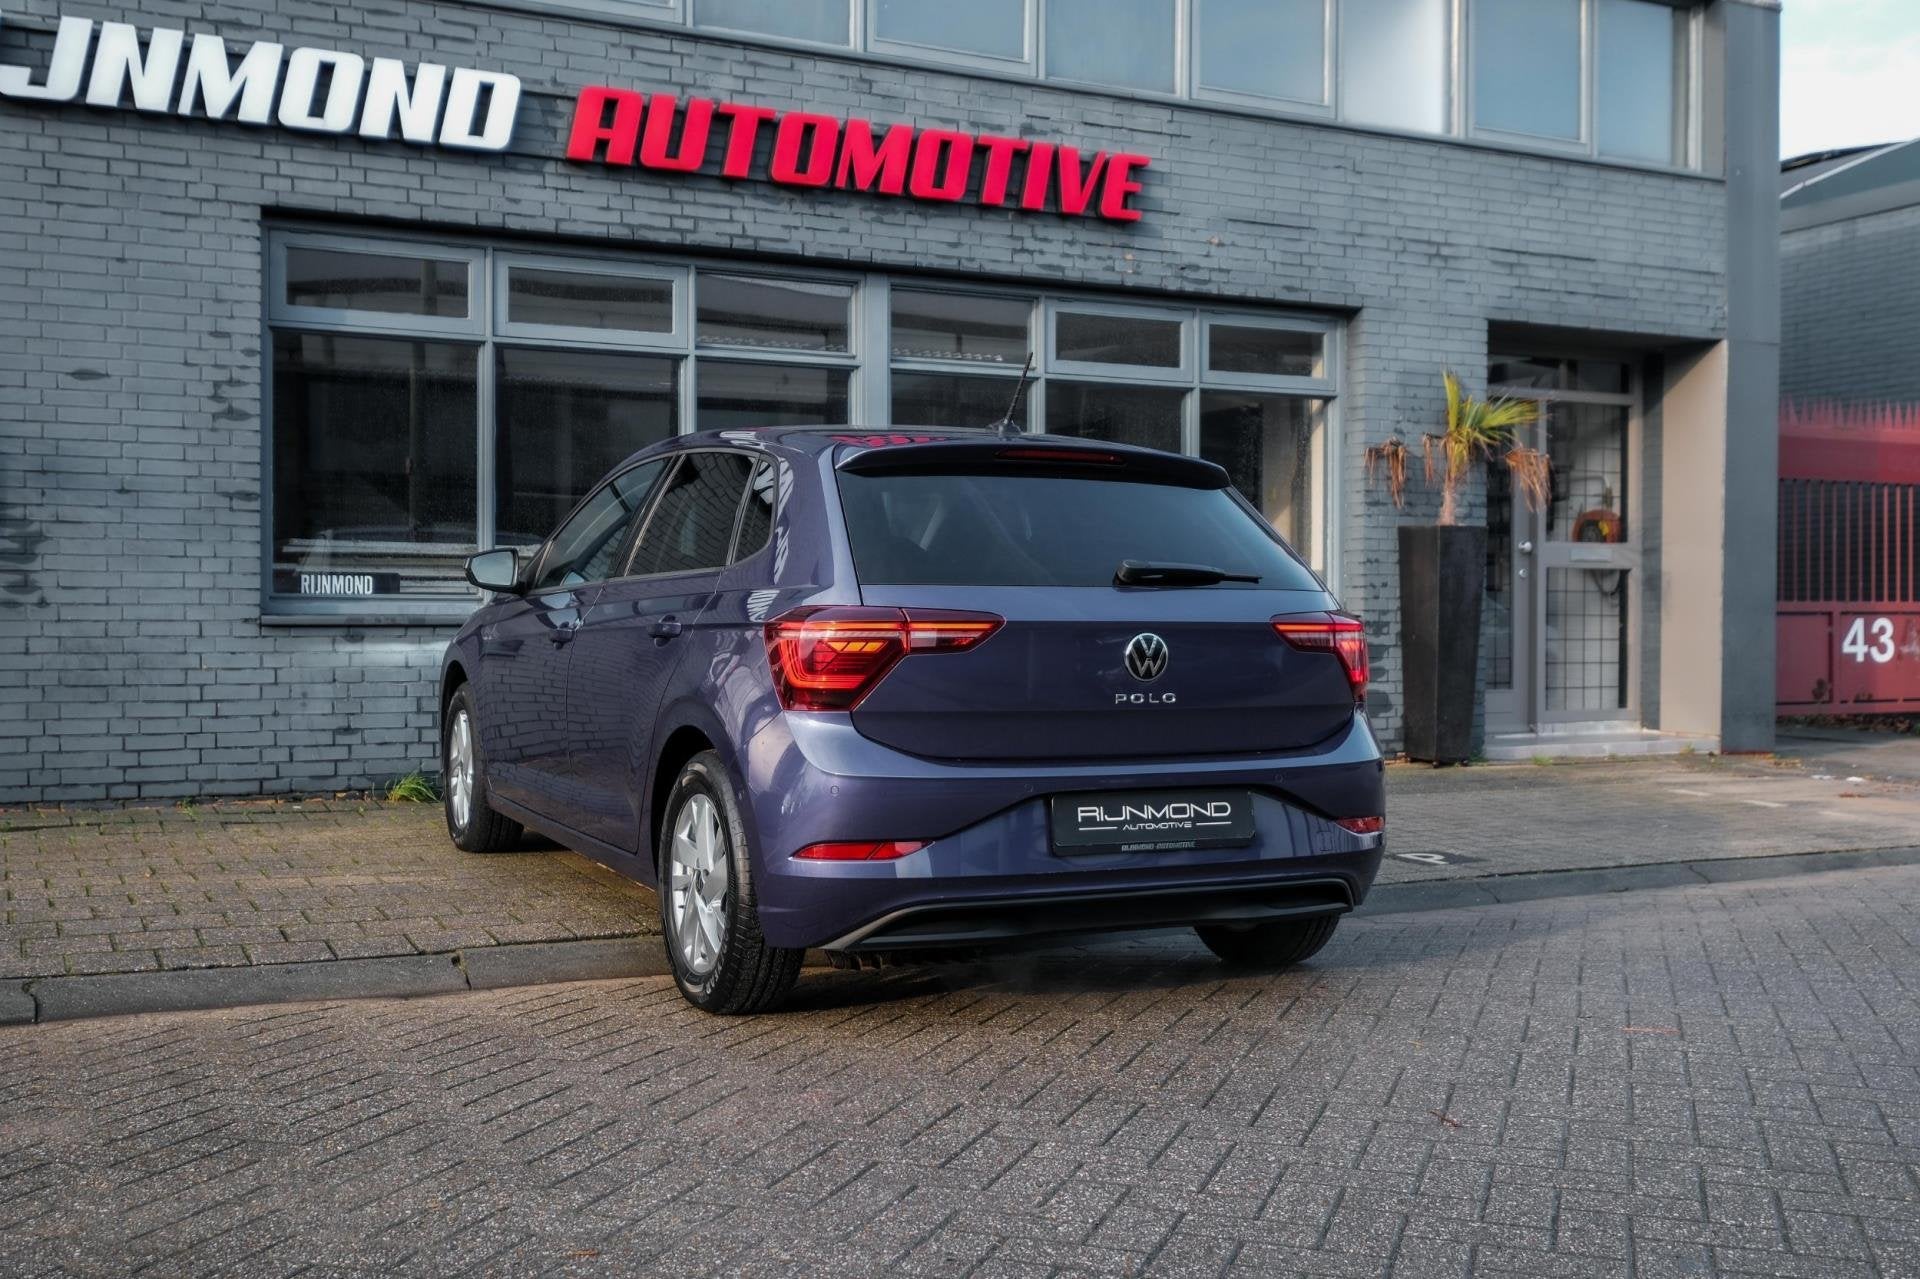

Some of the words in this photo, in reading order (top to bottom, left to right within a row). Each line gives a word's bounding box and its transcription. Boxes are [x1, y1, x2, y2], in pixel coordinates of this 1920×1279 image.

[0, 15, 521, 151] JNMOND
[566, 86, 1150, 221] AUTOMOTIVE
[301, 574, 373, 595] RIJNMOND
[1842, 617, 1895, 663] 43
[1115, 692, 1177, 704] POLO
[1077, 802, 1231, 822] RIJNMOND
[1122, 821, 1192, 831] AUTOMOTIVE
